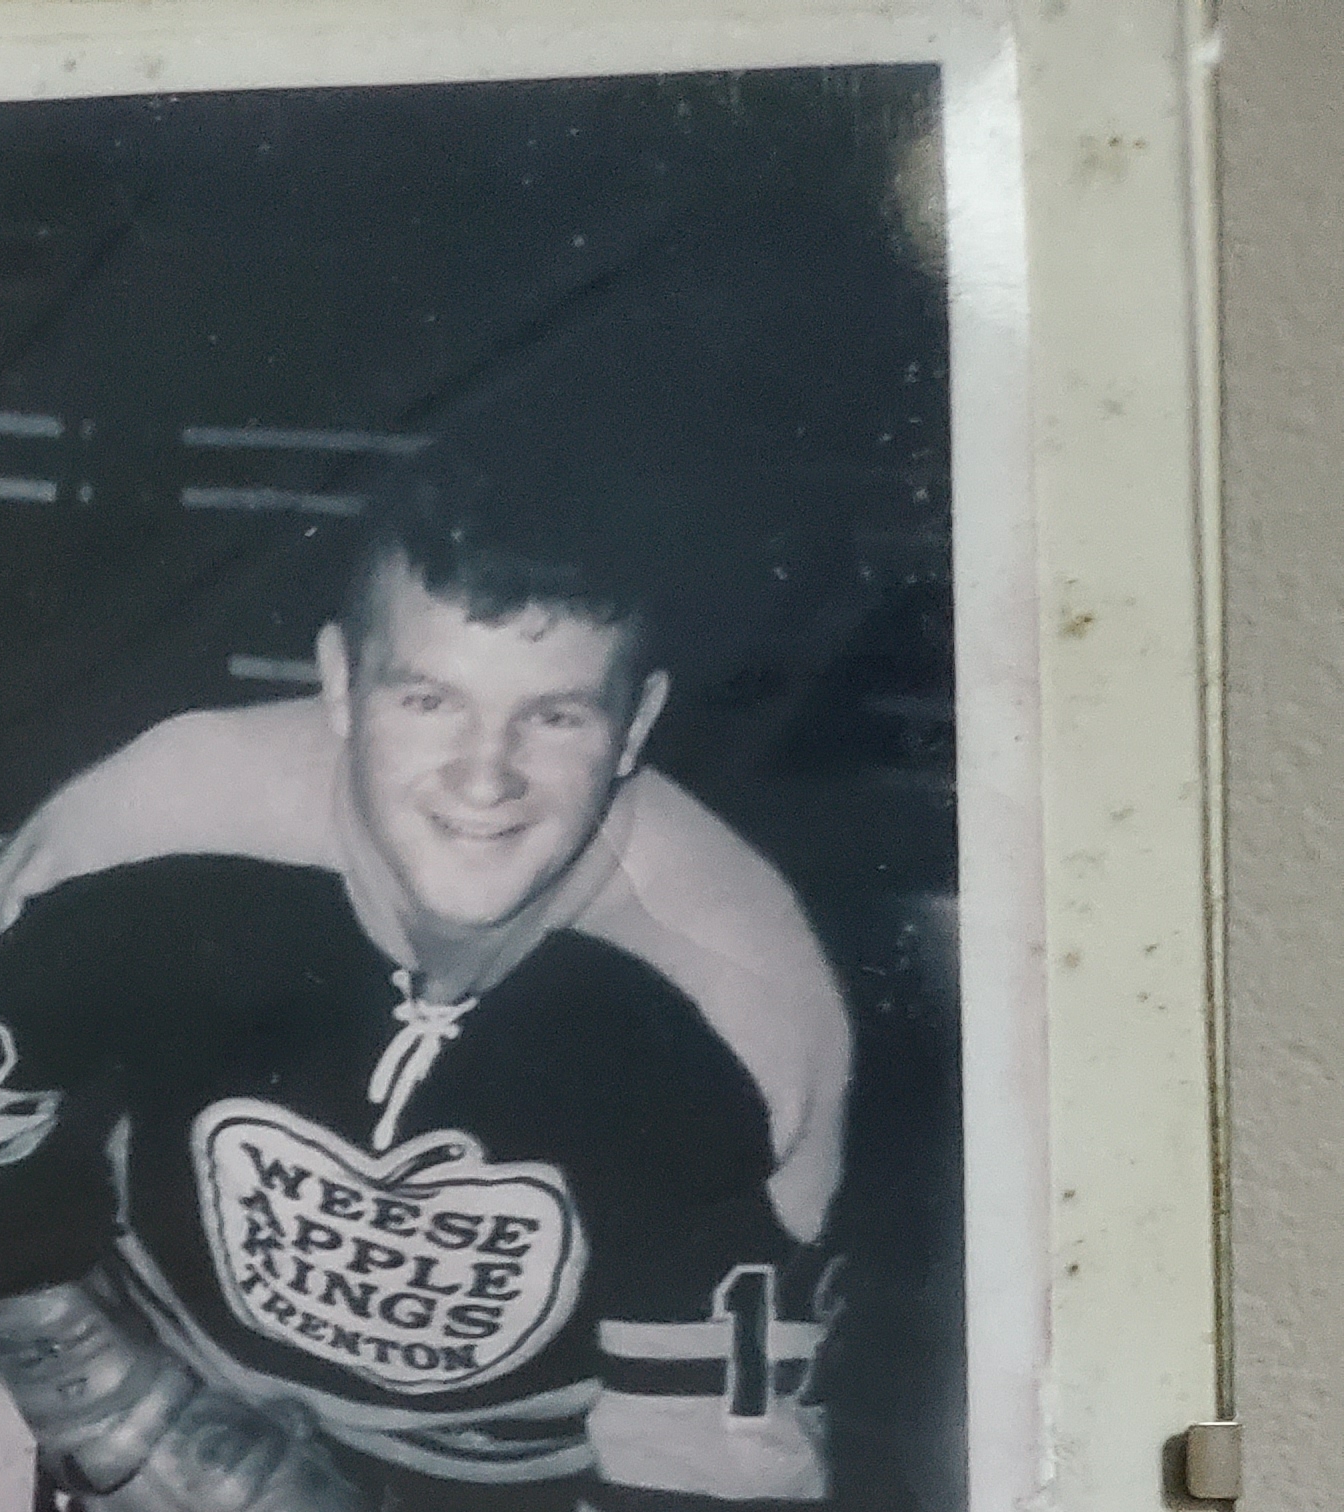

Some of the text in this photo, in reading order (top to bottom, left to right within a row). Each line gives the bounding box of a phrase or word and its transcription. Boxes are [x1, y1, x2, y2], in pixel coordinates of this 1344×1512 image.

[238, 1188, 524, 1301] APPLE
[239, 1142, 540, 1258] WEESE
[239, 1263, 480, 1371] TRENTON
[242, 1214, 506, 1339] KINGS
